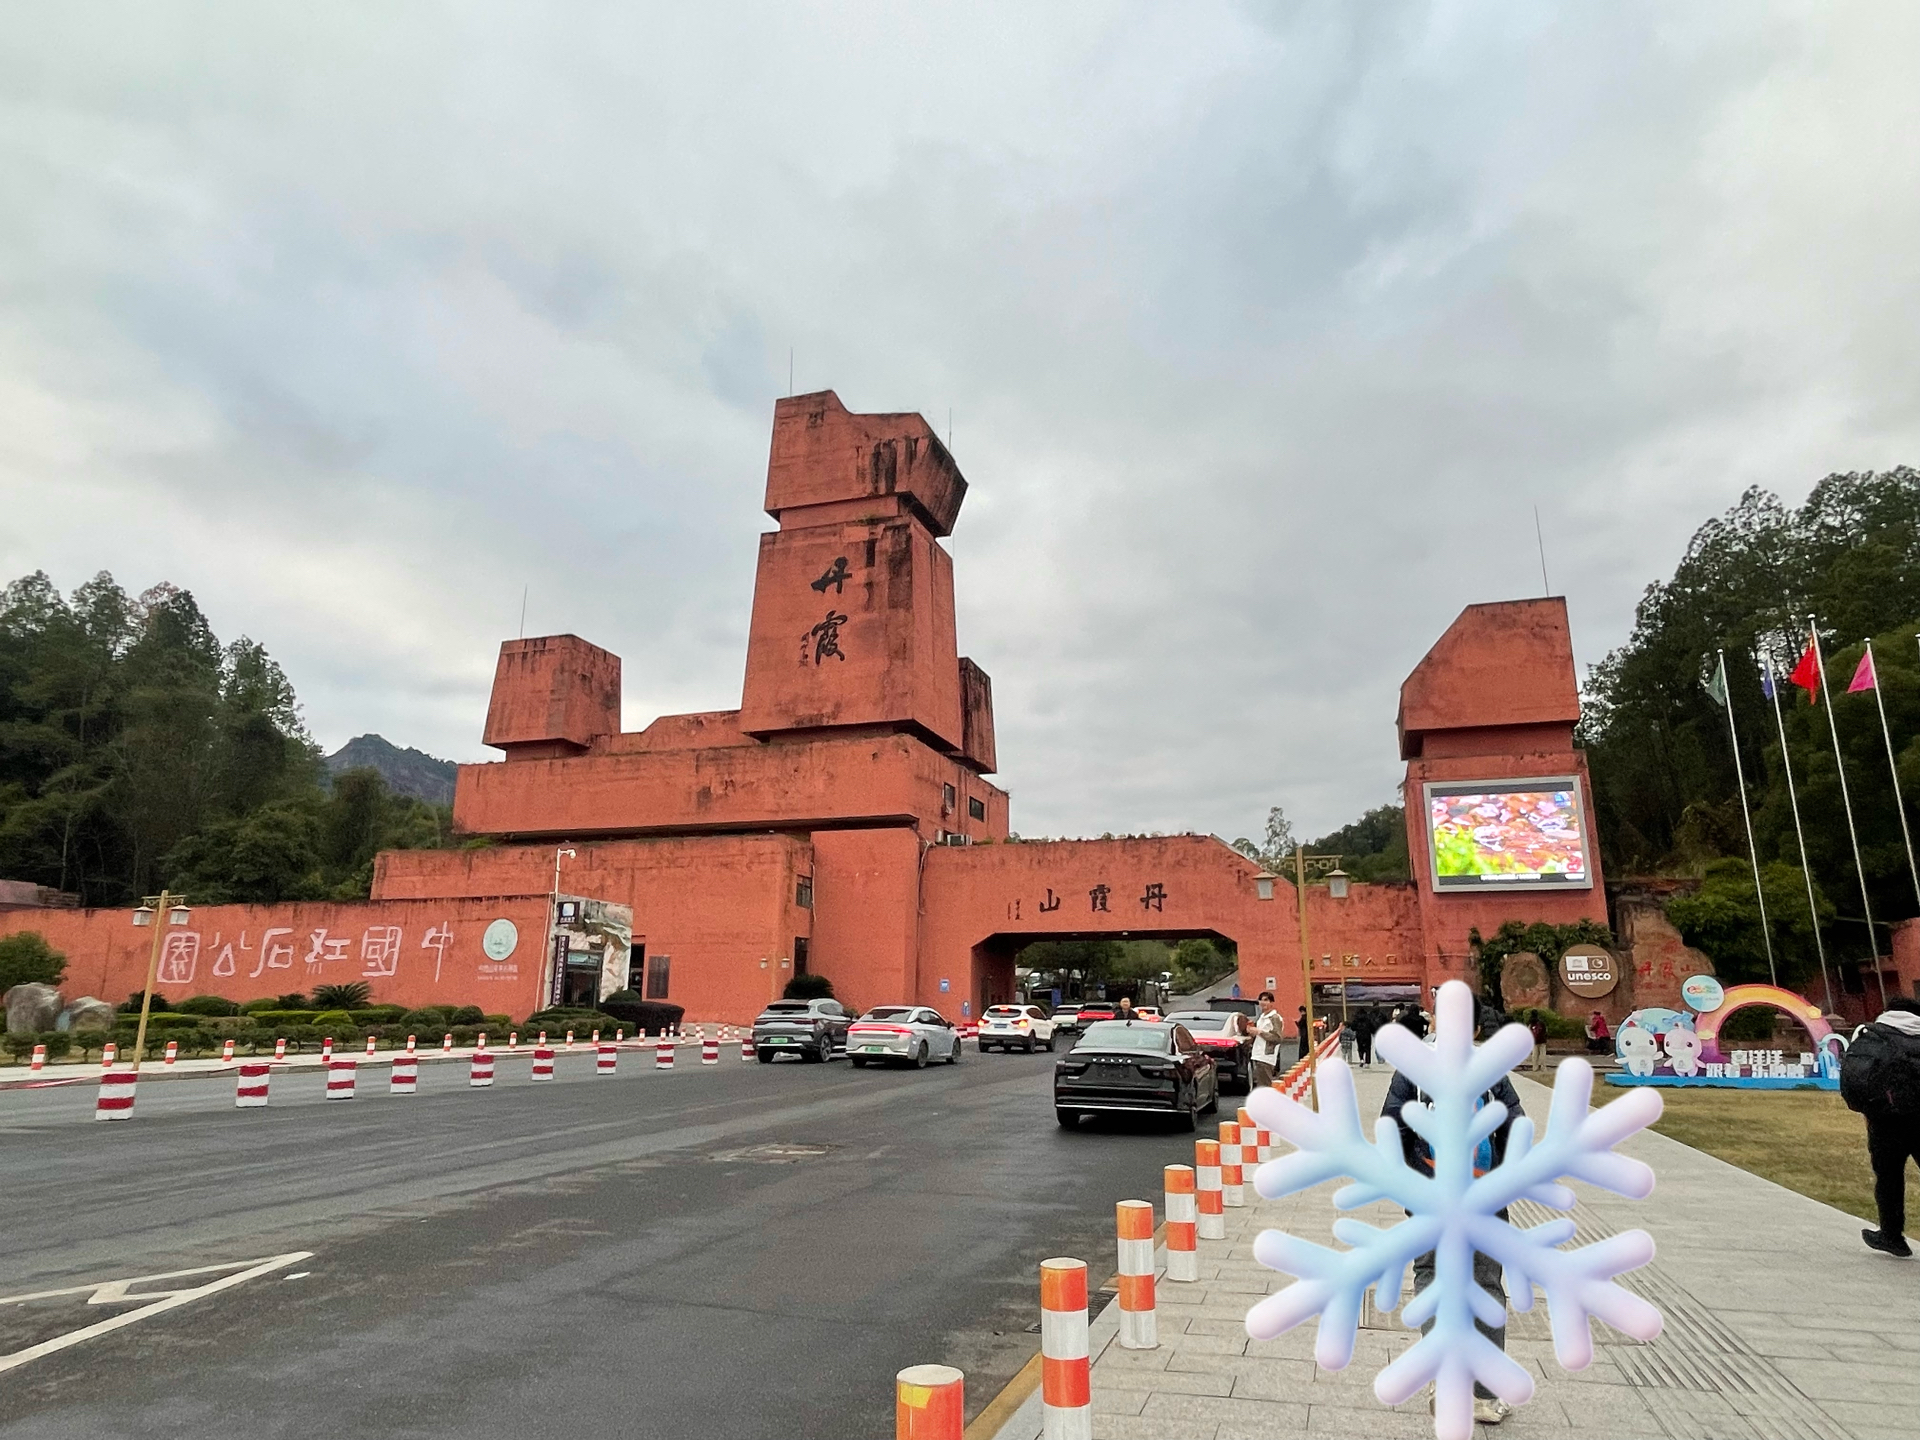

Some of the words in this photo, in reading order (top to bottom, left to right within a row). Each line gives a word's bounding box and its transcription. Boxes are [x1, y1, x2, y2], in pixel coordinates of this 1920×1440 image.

[1039, 883, 1167, 912] 丹霞山
[1567, 972, 1611, 981] unesco
